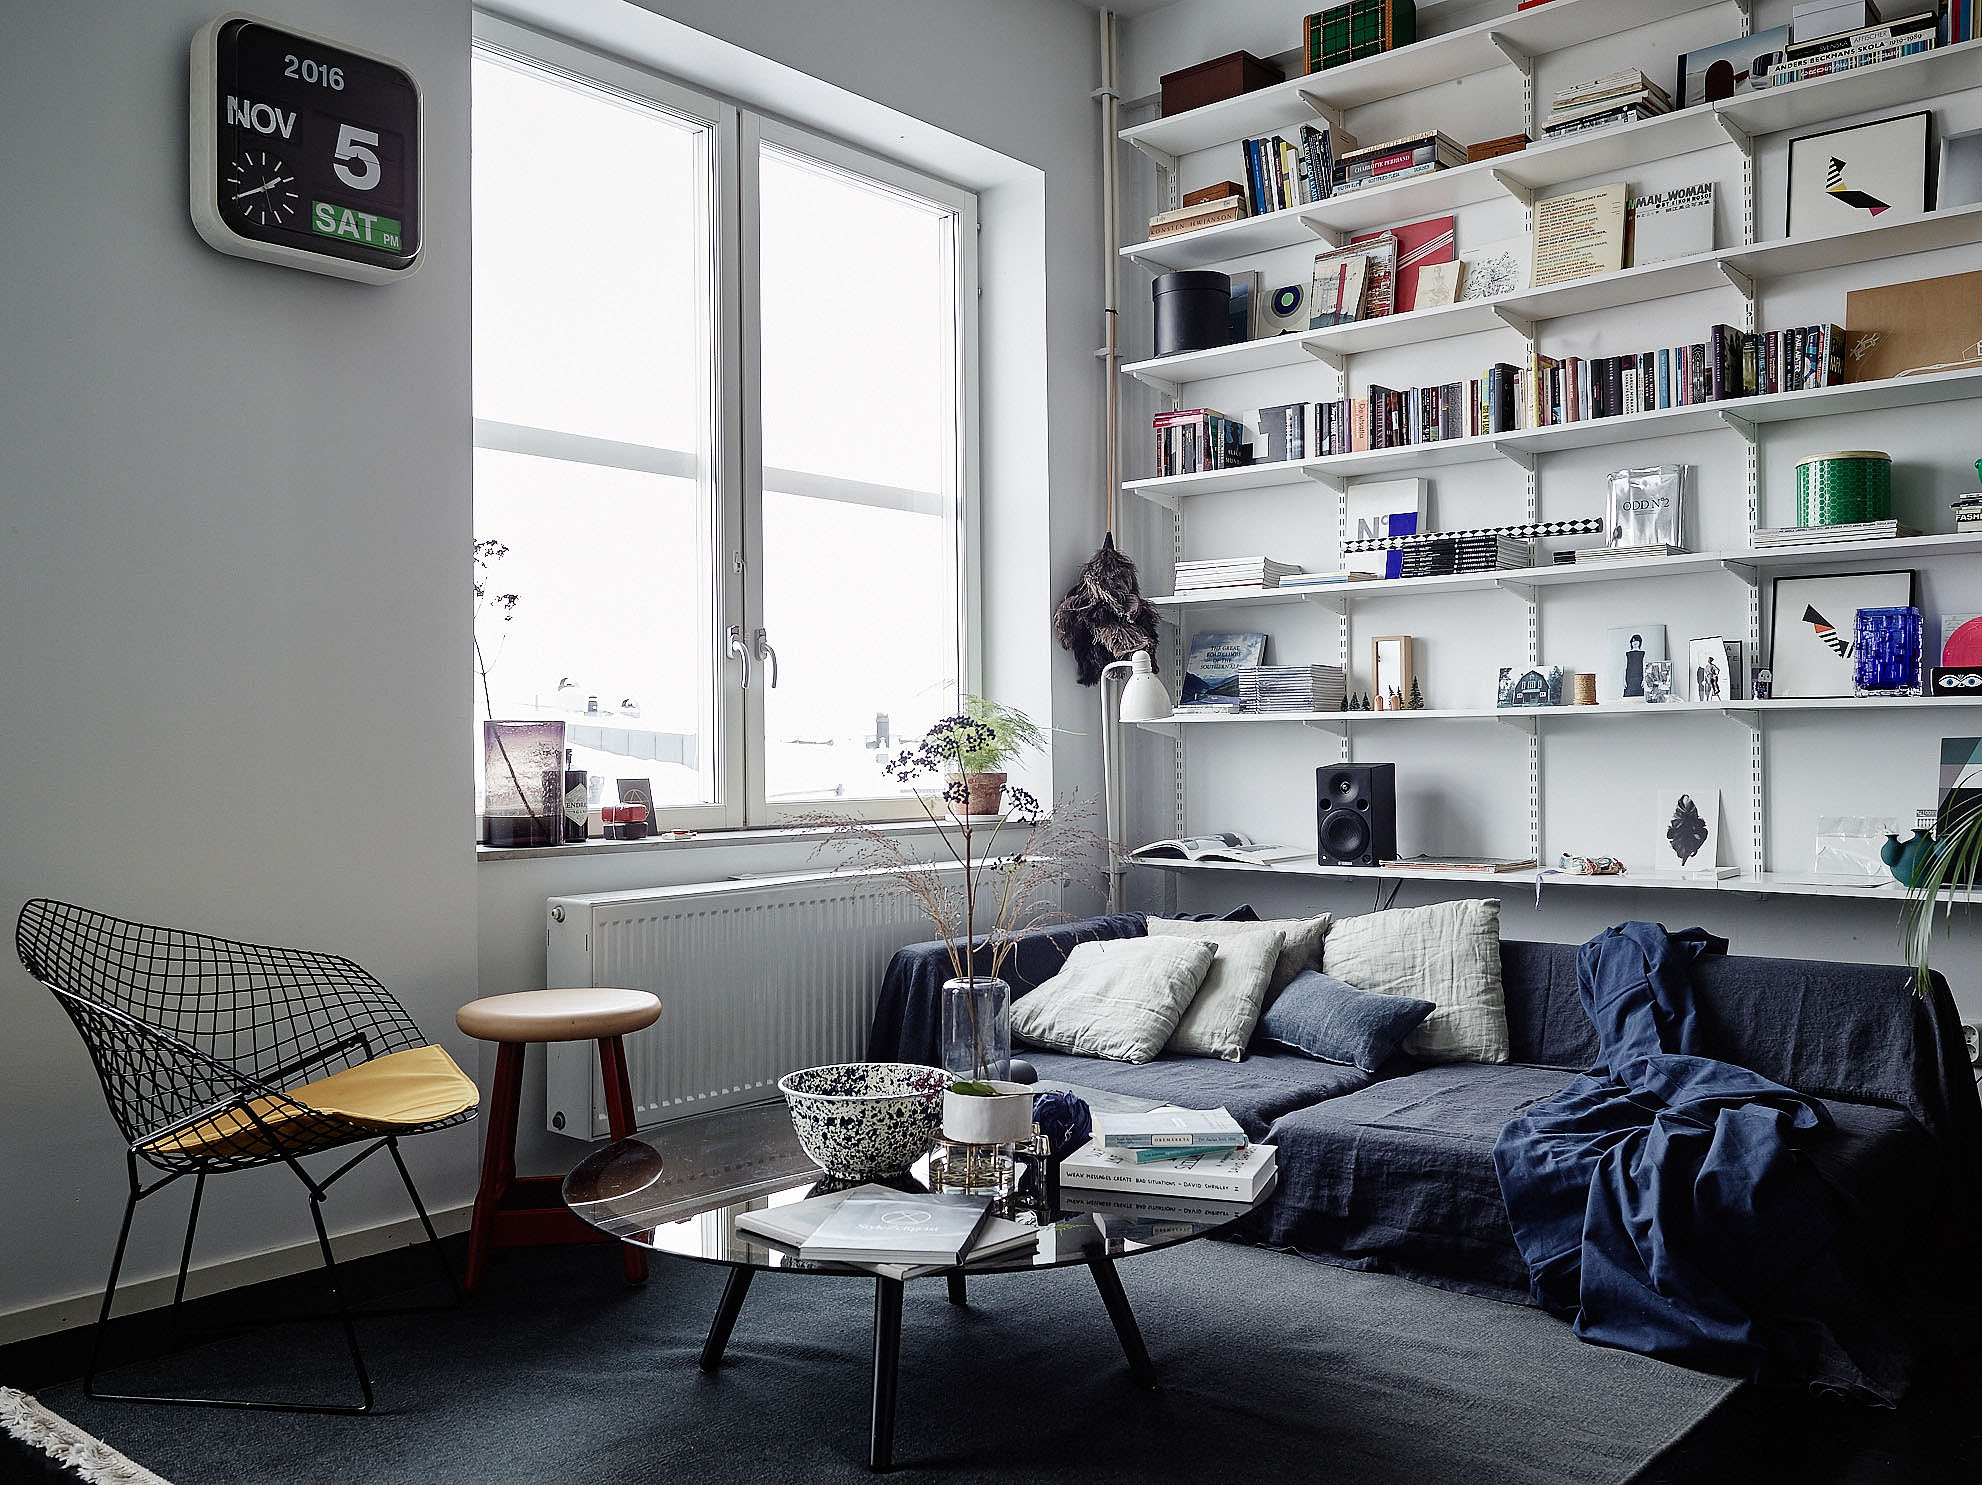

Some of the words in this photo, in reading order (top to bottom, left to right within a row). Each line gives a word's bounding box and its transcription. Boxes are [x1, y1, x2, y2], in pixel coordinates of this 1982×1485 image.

[1819, 41, 1849, 51] SVENSKA
[1853, 30, 1888, 44] AFFISCHER
[1775, 57, 1807, 72] ANDERS
[1809, 48, 1855, 64] BECKMANS
[1857, 41, 1885, 53] SKOLA
[284, 54, 345, 91] 2016
[227, 95, 297, 139] NOV
[333, 123, 382, 191] 5
[1354, 161, 1383, 174] CHARLOTTE
[1384, 155, 1410, 167] PERRIAND
[315, 202, 378, 241] SAT
[383, 233, 399, 248] PM
[1150, 223, 1185, 235] KONSTEN
[1623, 500, 1650, 511] ODD
[1086, 1173, 1112, 1181] MESSAGES
[1113, 1175, 1132, 1183] CREATE
[1147, 1178, 1176, 1187] SITUATIONS
[1183, 1181, 1202, 1189] DAVID
